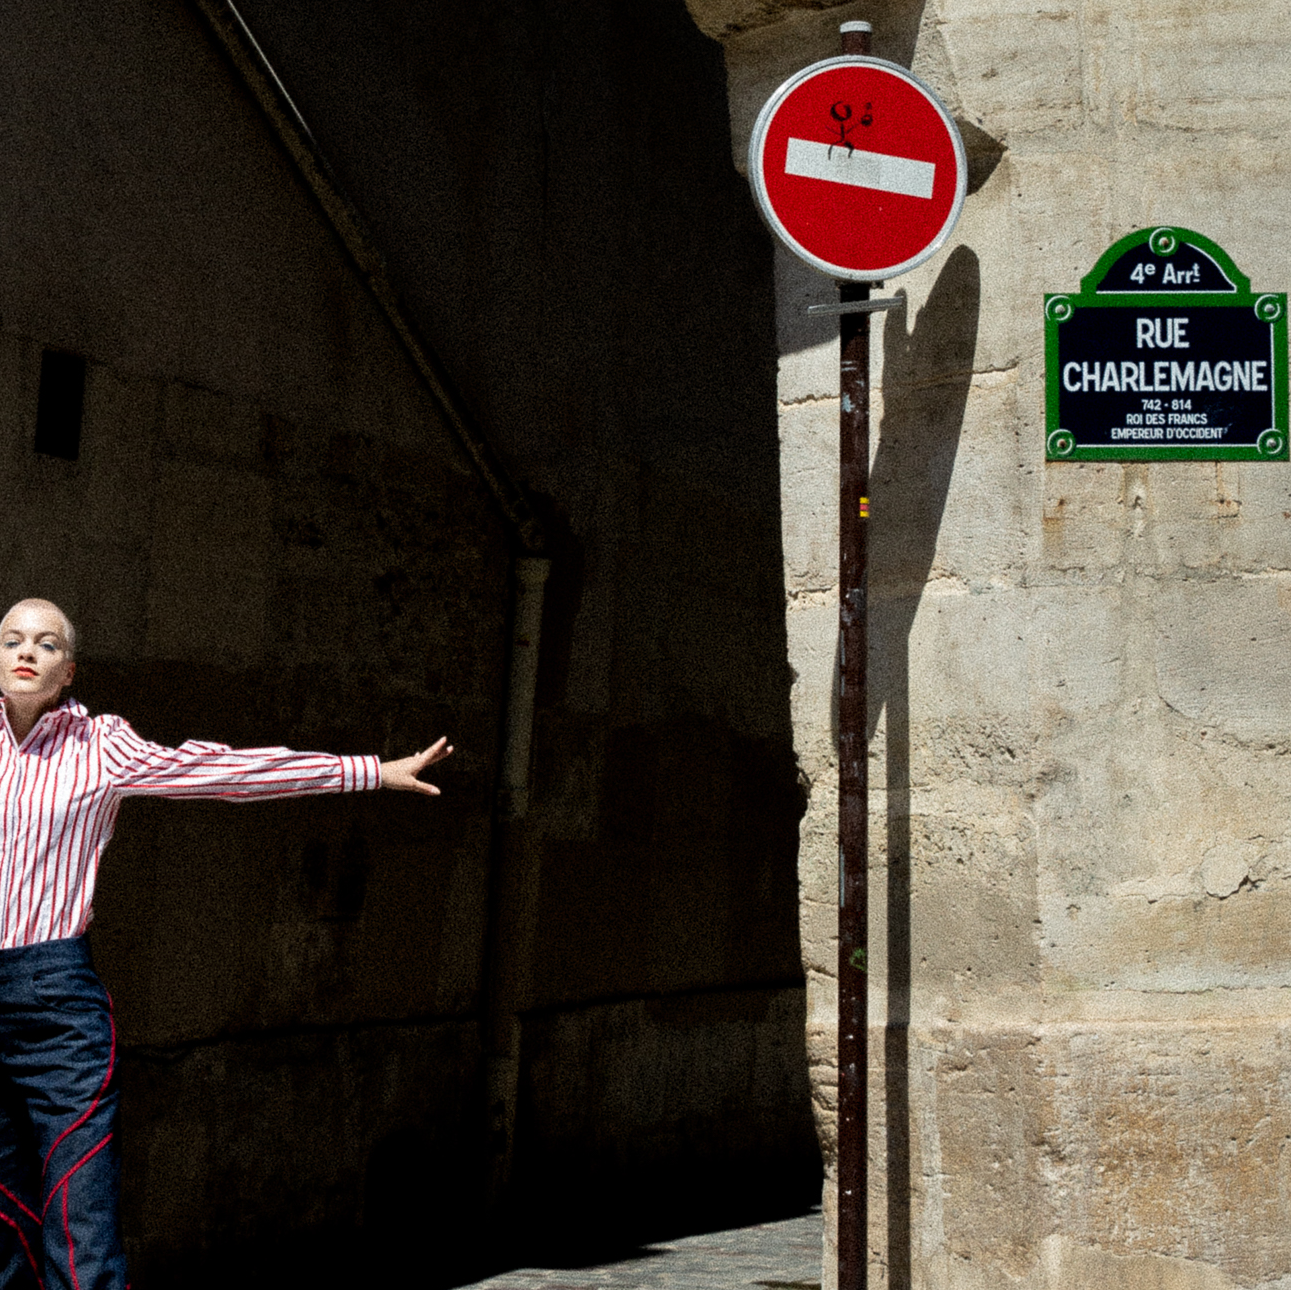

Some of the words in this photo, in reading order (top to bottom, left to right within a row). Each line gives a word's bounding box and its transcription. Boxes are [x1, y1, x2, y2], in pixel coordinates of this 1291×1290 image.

[1129, 262, 1156, 285] 4e
[1162, 262, 1200, 285] Arrt
[1136, 317, 1190, 349] RUE
[1062, 360, 1269, 392] CHARLEMAGNE
[1141, 398, 1162, 411] 742
[1171, 398, 1192, 411] 814
[1126, 413, 1144, 425] ROI
[1145, 413, 1166, 425] DES
[1168, 413, 1208, 425] FRANCS
[1110, 427, 1164, 440] EMPEREUR
